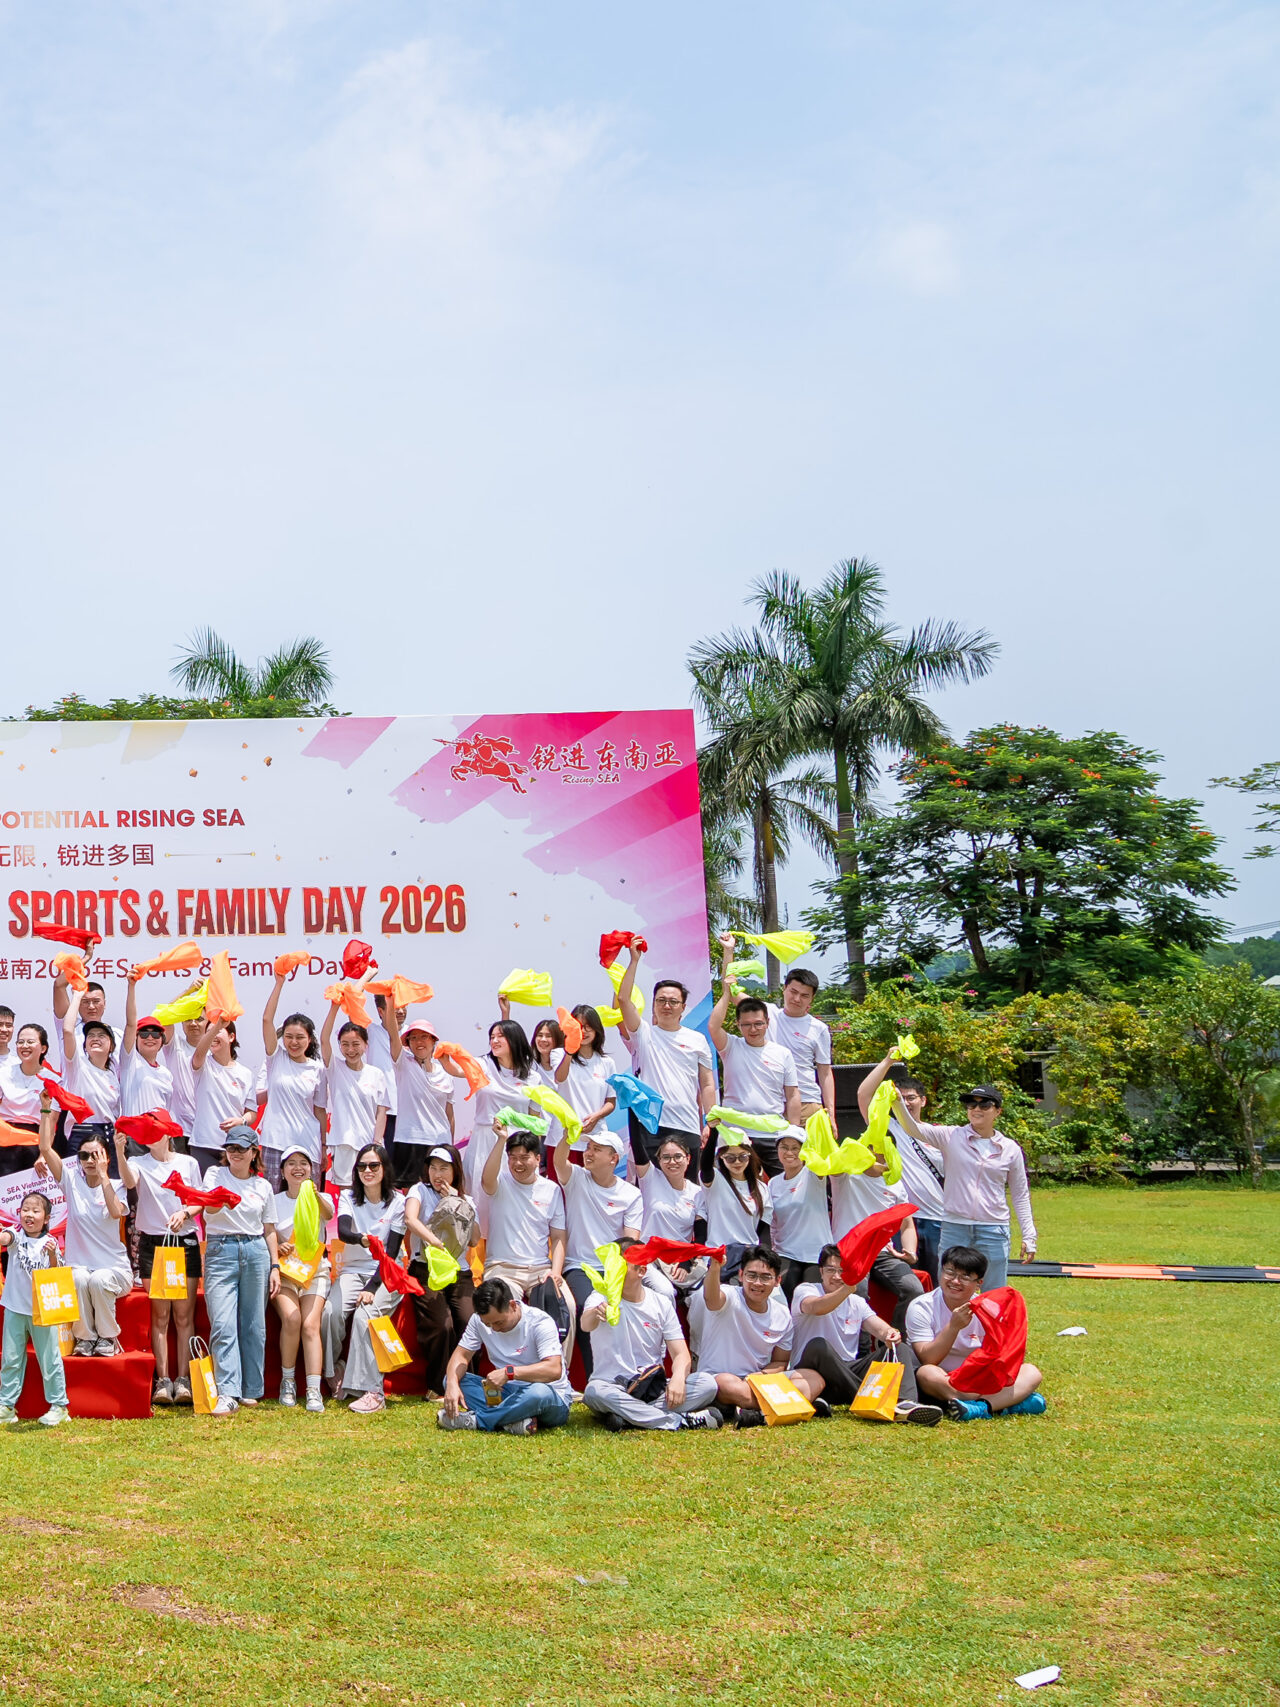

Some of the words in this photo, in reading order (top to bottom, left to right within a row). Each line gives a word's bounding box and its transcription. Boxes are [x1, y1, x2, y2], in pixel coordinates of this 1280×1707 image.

[530, 740, 682, 772] 锐进东南亚
[561, 774, 594, 786] Rising
[596, 773, 620, 783] SEA
[116, 809, 195, 828] RISING
[202, 808, 245, 827] SEA
[8, 889, 141, 938] SPORTS
[176, 887, 292, 937] FAMILY
[302, 886, 367, 936] DAY
[379, 884, 466, 935] 2026
[228, 956, 299, 981] Famy
[6, 1185, 20, 1195] SEA
[21, 1179, 47, 1190] Vietnam
[1, 1194, 22, 1204] Sports
[40, 1282, 59, 1296] OH!
[43, 1294, 74, 1311] SOME
